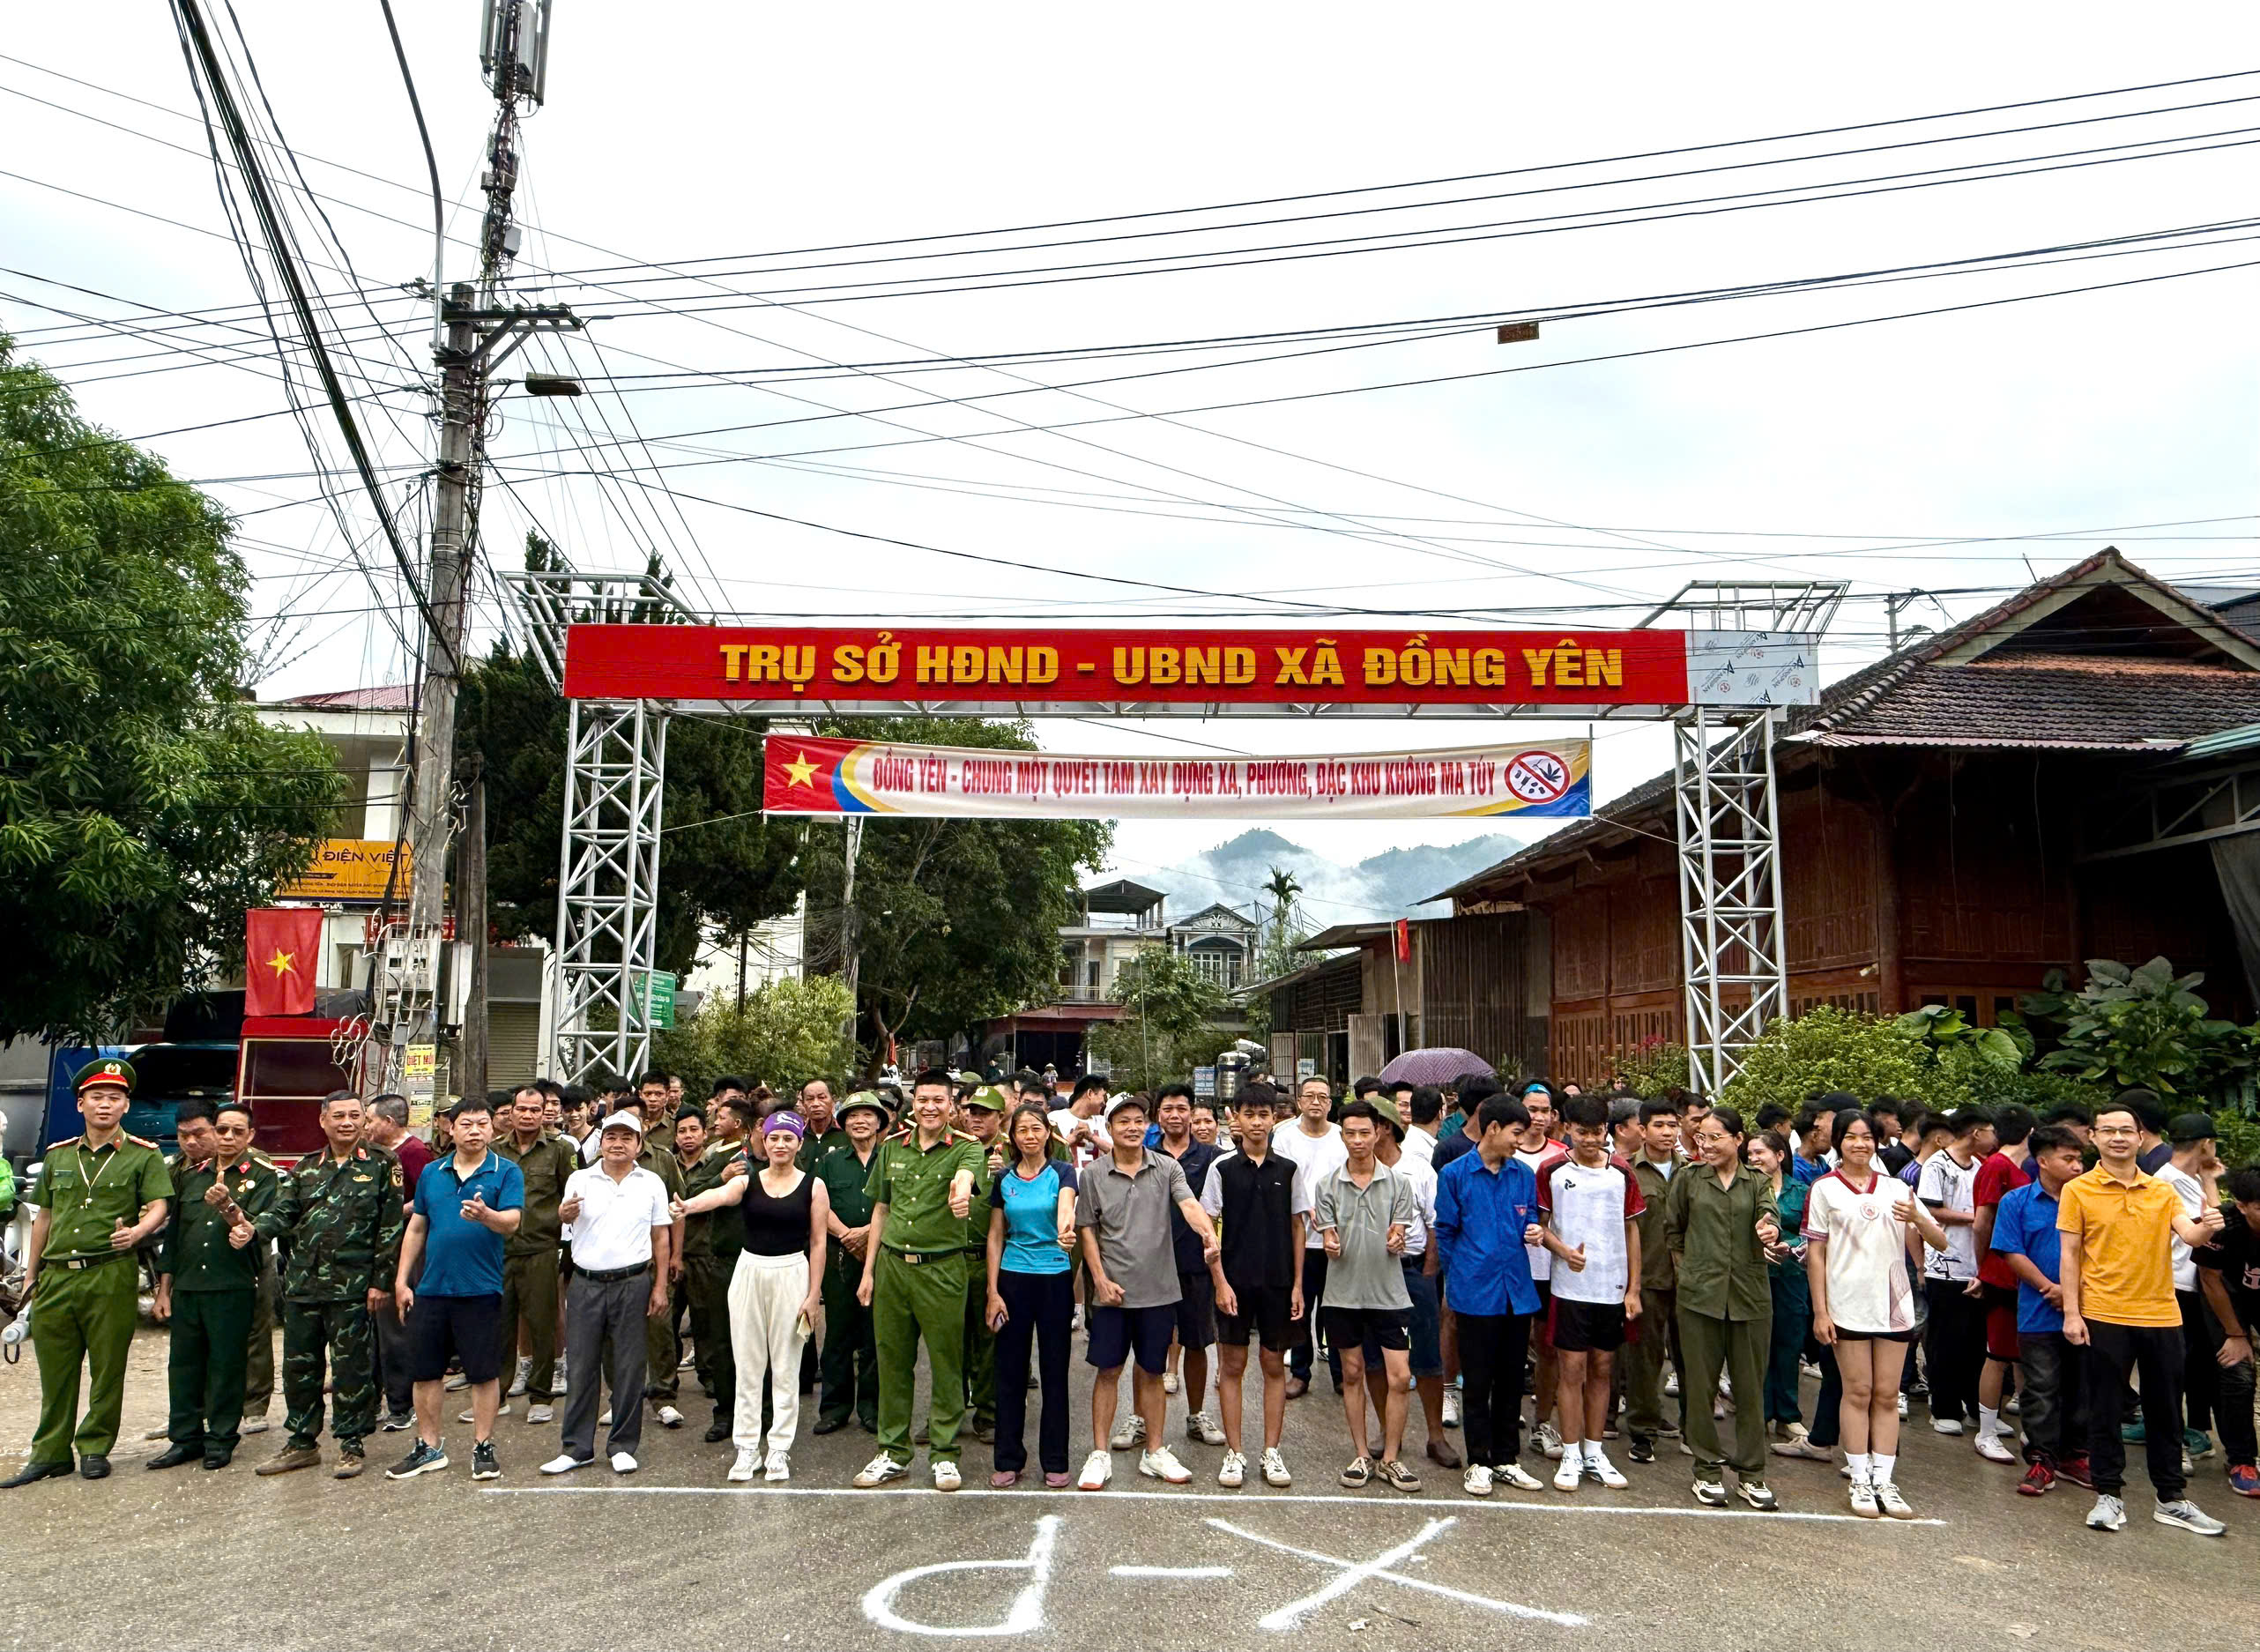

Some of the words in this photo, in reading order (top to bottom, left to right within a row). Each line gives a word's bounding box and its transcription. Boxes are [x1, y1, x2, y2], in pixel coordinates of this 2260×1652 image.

[719, 644, 816, 692] TRỤ
[832, 631, 903, 682] SỞ
[916, 645, 1059, 684] HĐND
[1113, 646, 1257, 685] UBND
[1275, 638, 1345, 685] XÃ
[1363, 633, 1505, 686] ĐỒNG
[1522, 638, 1623, 687] YÊN
[918, 752, 948, 793] YÊN
[963, 759, 1012, 794] CHUNG
[1173, 761, 1213, 803] DỰNG
[1350, 762, 1381, 796] KHU
[1385, 755, 1437, 796] KHÔNG
[1441, 762, 1466, 795] MA
[1468, 755, 1496, 796] TÚY
[323, 848, 365, 865] ĐIỆN
